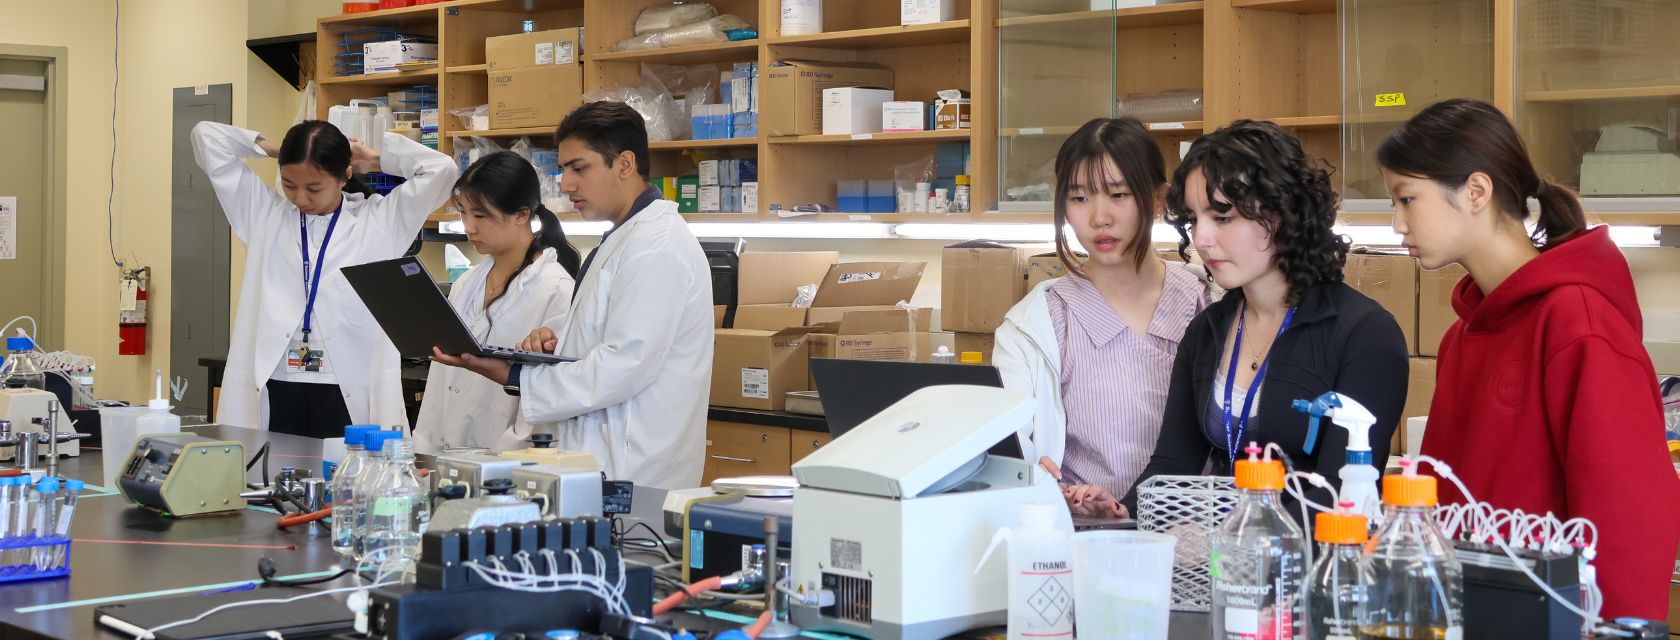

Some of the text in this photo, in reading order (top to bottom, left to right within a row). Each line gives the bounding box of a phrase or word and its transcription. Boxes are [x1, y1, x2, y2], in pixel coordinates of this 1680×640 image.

[814, 71, 833, 79] Syringe
[1379, 93, 1400, 104] SSP
[1033, 561, 1067, 571] ETHANOL
